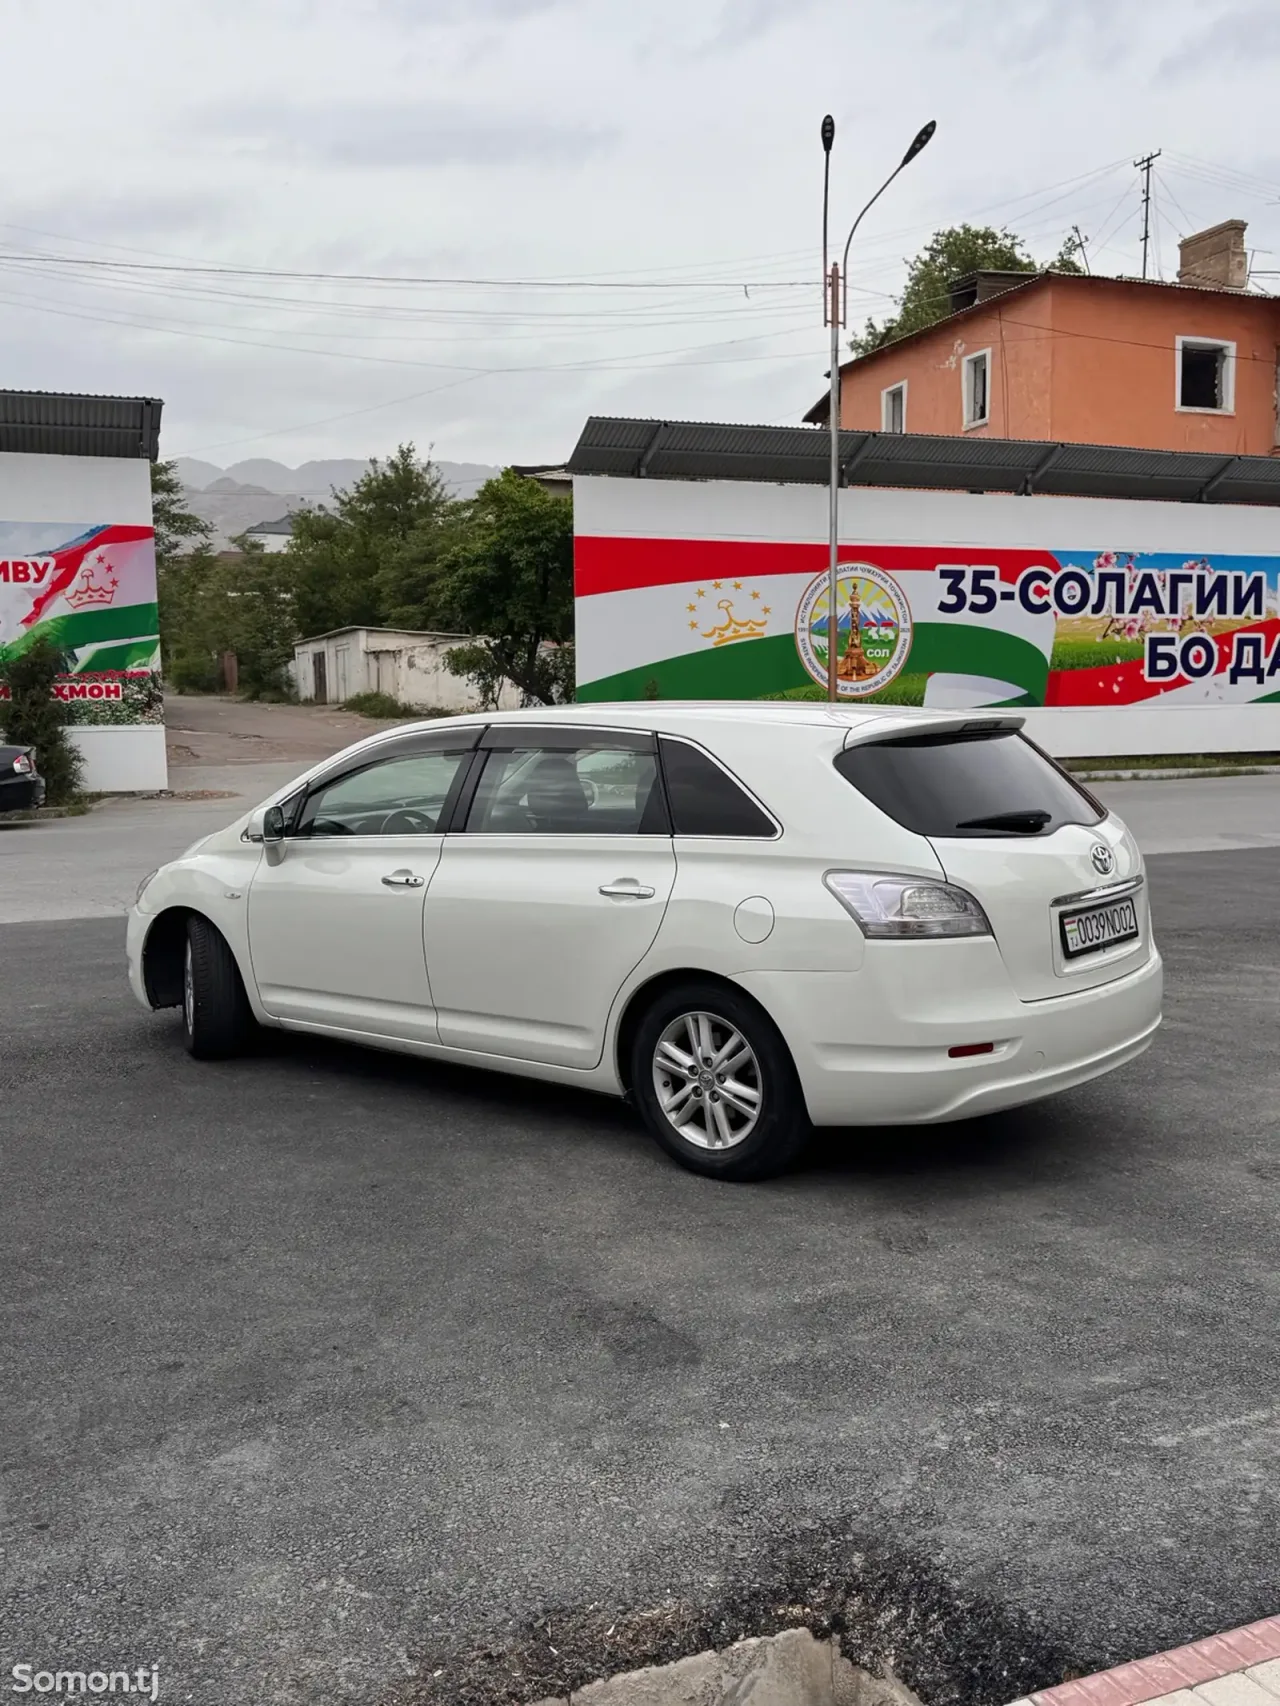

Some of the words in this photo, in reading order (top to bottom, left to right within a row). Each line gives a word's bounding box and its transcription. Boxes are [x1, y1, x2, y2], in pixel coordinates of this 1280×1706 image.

[937, 568, 1264, 616] 35-СОЛАГИИ
[863, 620, 895, 645] 35
[1147, 635, 1216, 679] БО
